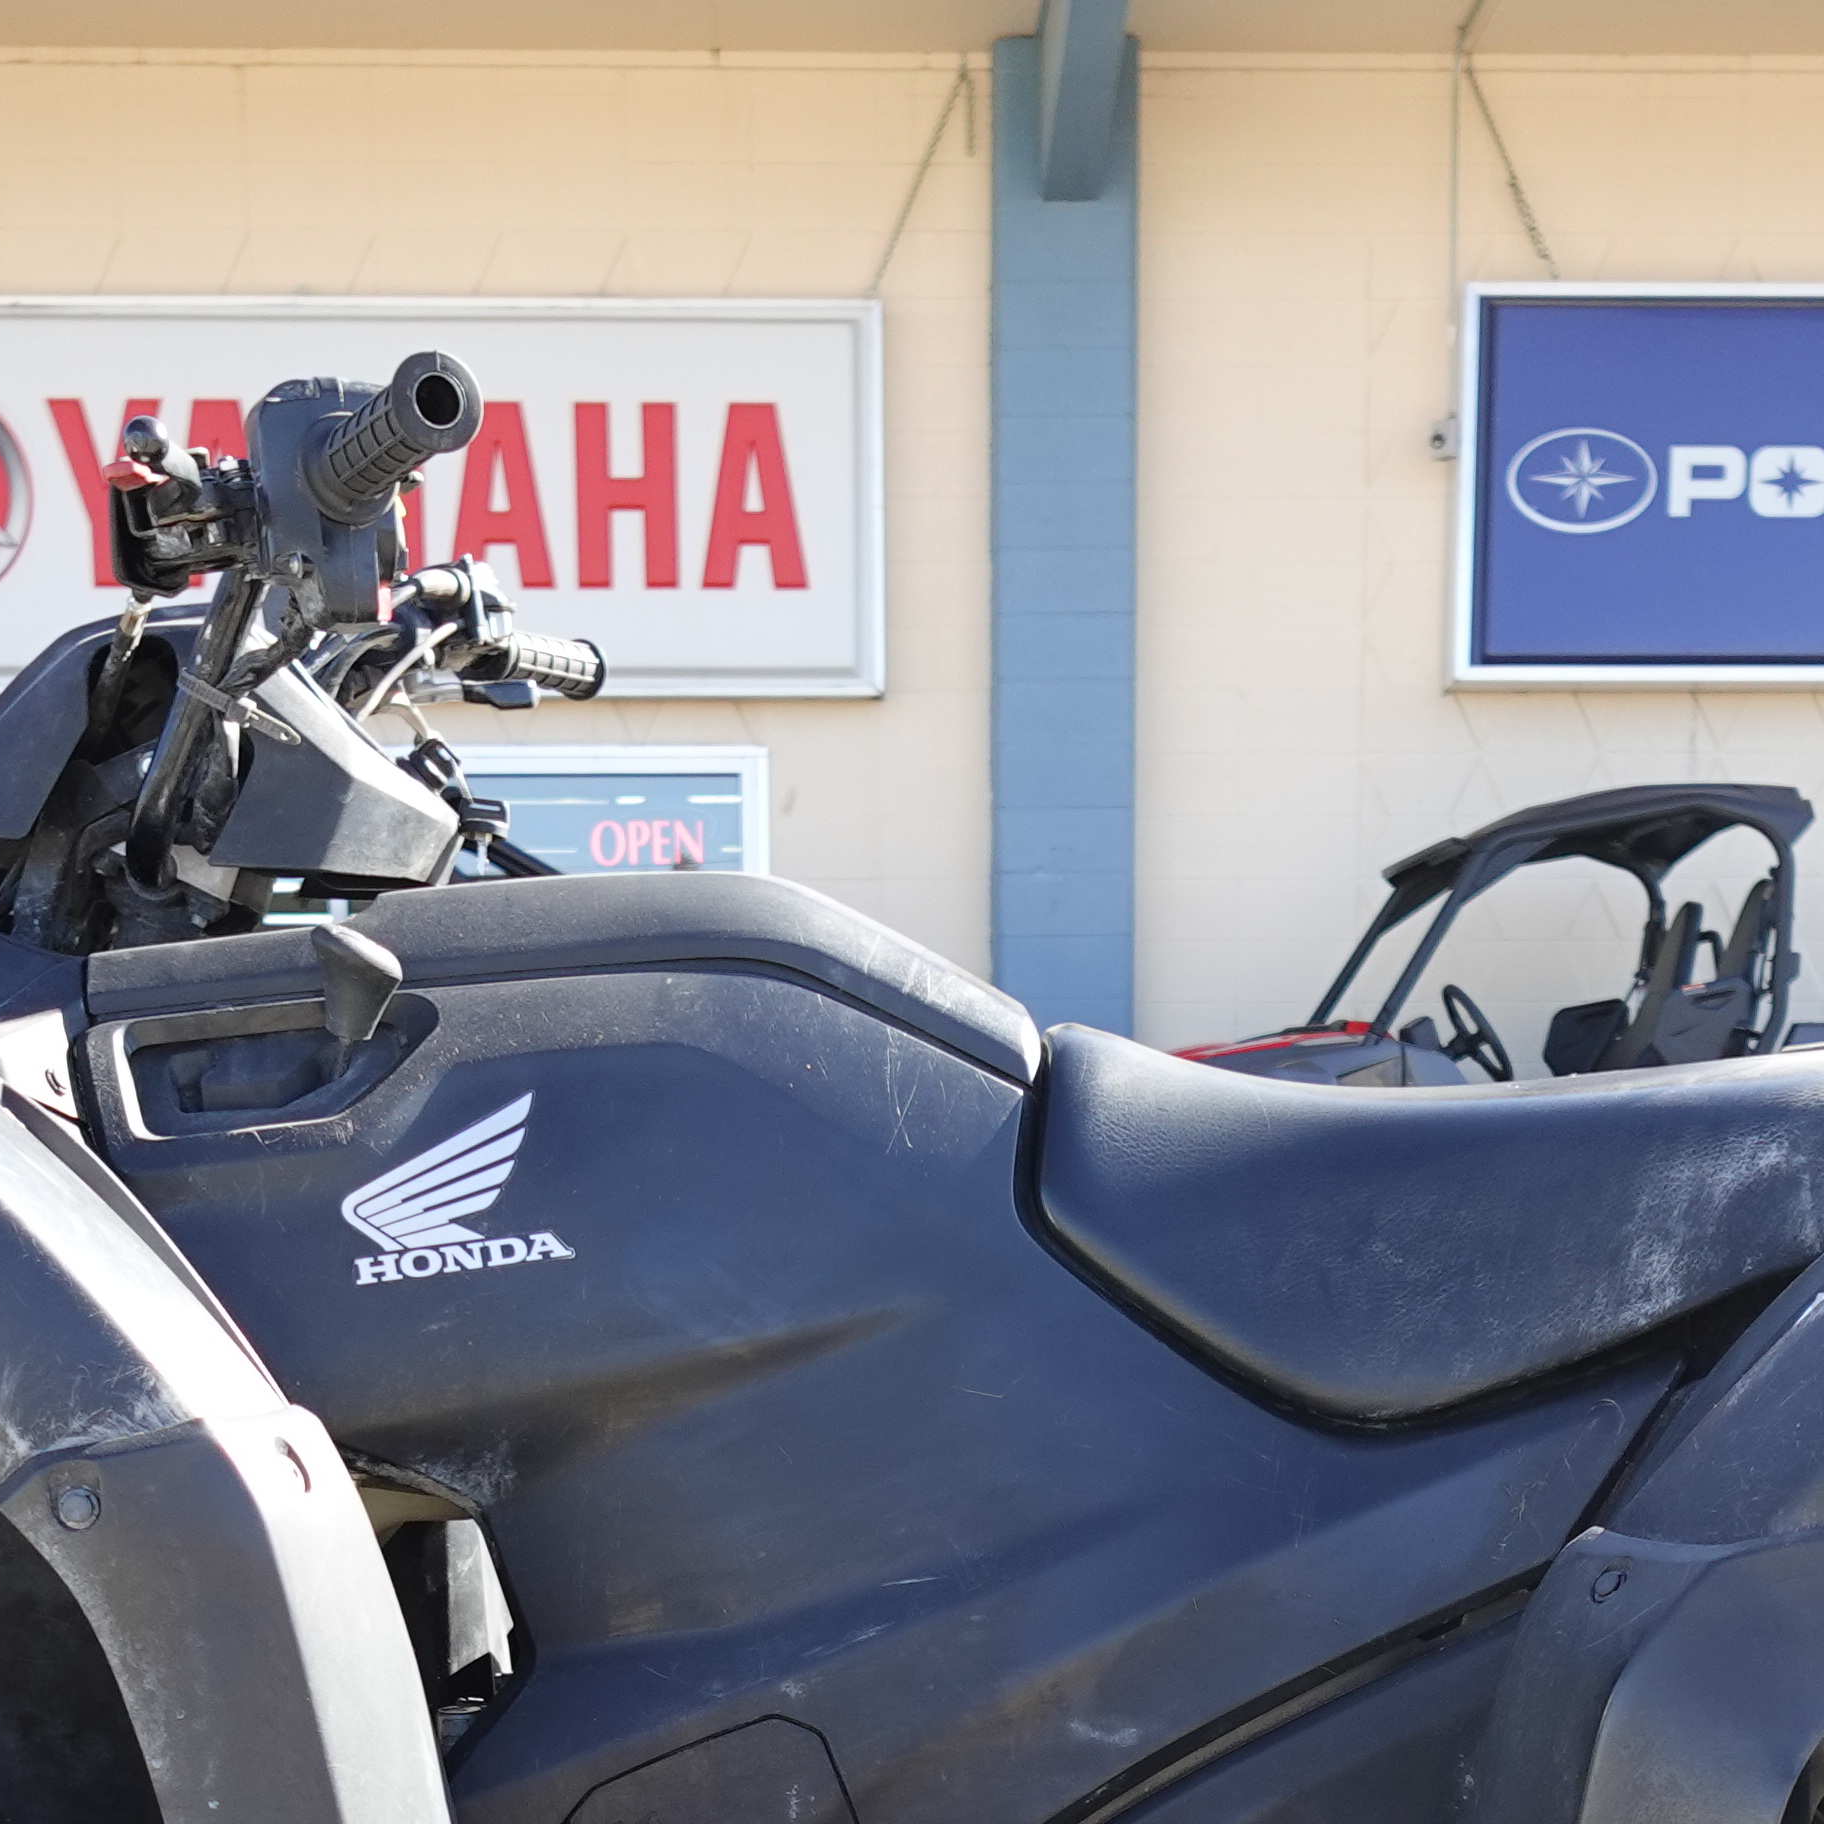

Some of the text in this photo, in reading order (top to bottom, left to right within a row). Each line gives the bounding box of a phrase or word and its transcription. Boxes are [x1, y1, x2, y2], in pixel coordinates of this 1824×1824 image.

[48, 399, 810, 589] YAHA
[590, 819, 704, 867] OPEN
[355, 1231, 573, 1286] HONDA
